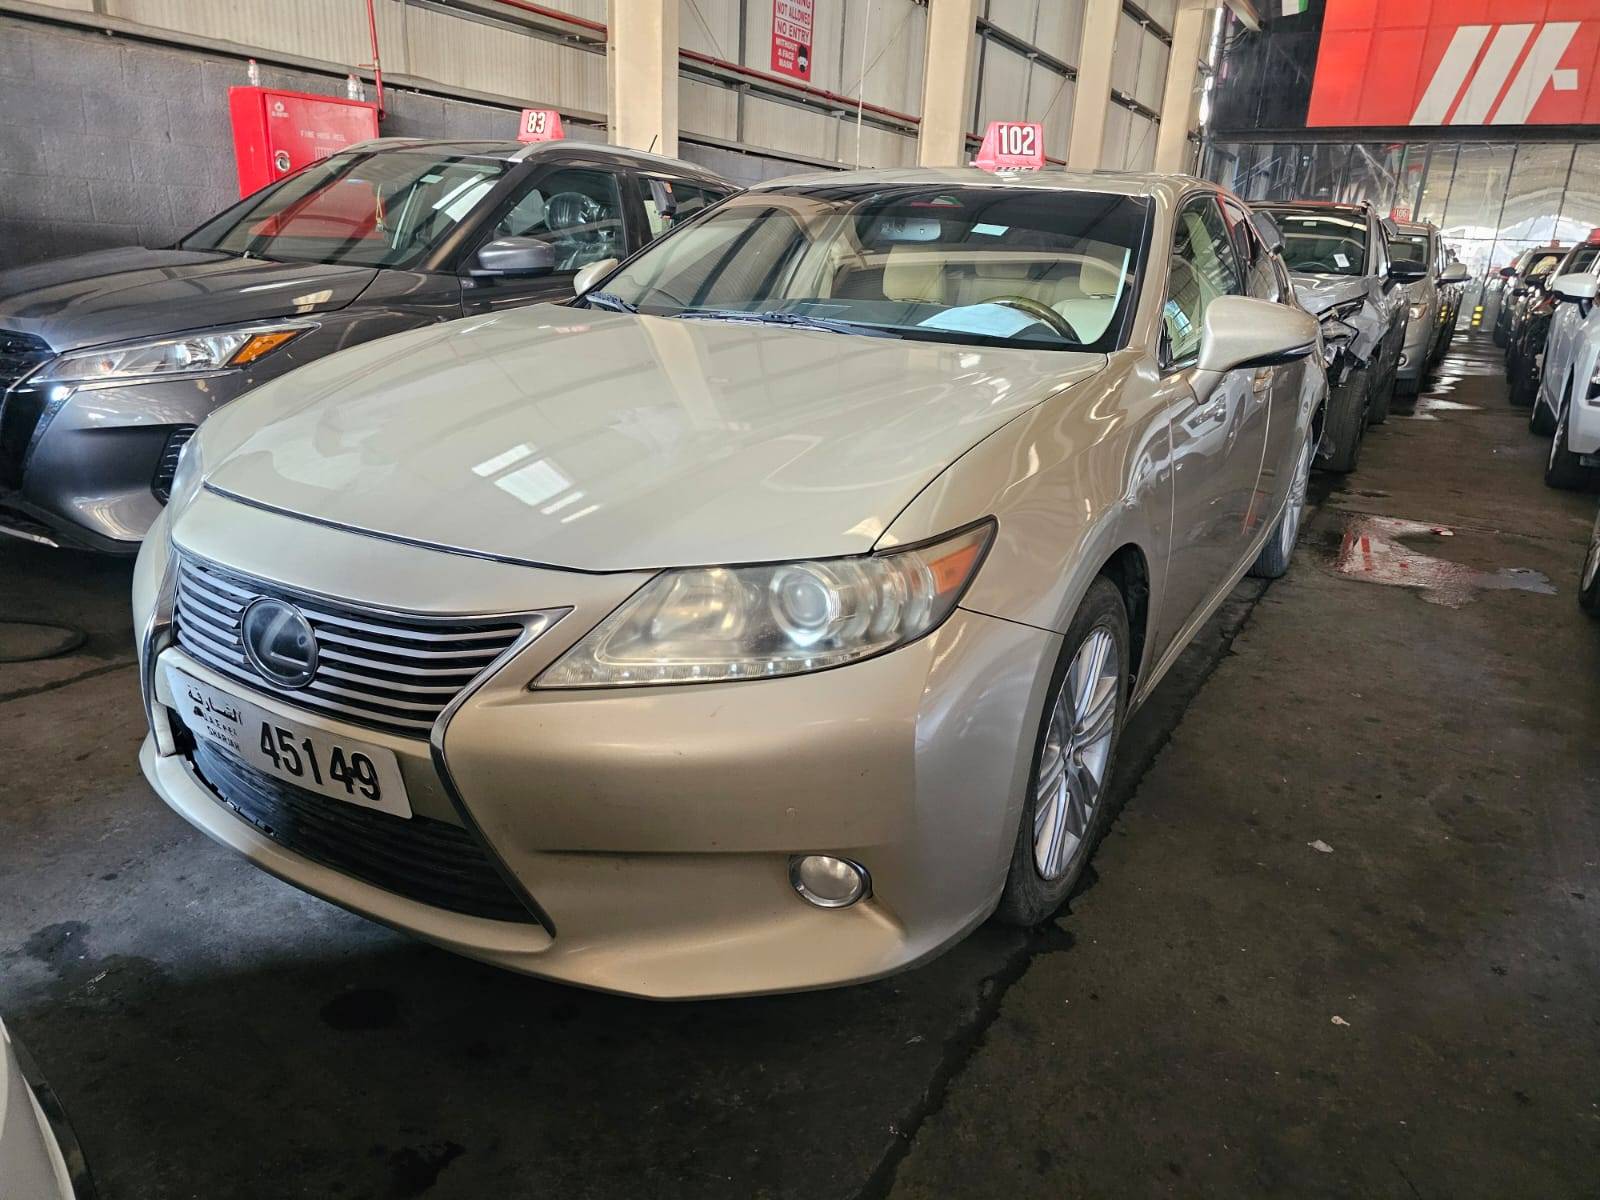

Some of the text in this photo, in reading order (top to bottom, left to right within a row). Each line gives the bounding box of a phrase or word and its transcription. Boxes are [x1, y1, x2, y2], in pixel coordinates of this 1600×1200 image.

[777, 2, 788, 16] NOT
[789, 6, 811, 26] ALLOWED
[777, 20, 810, 44] NO ENTRY
[527, 111, 546, 133] 83
[999, 124, 1035, 155] 102
[259, 720, 381, 801] 45149
